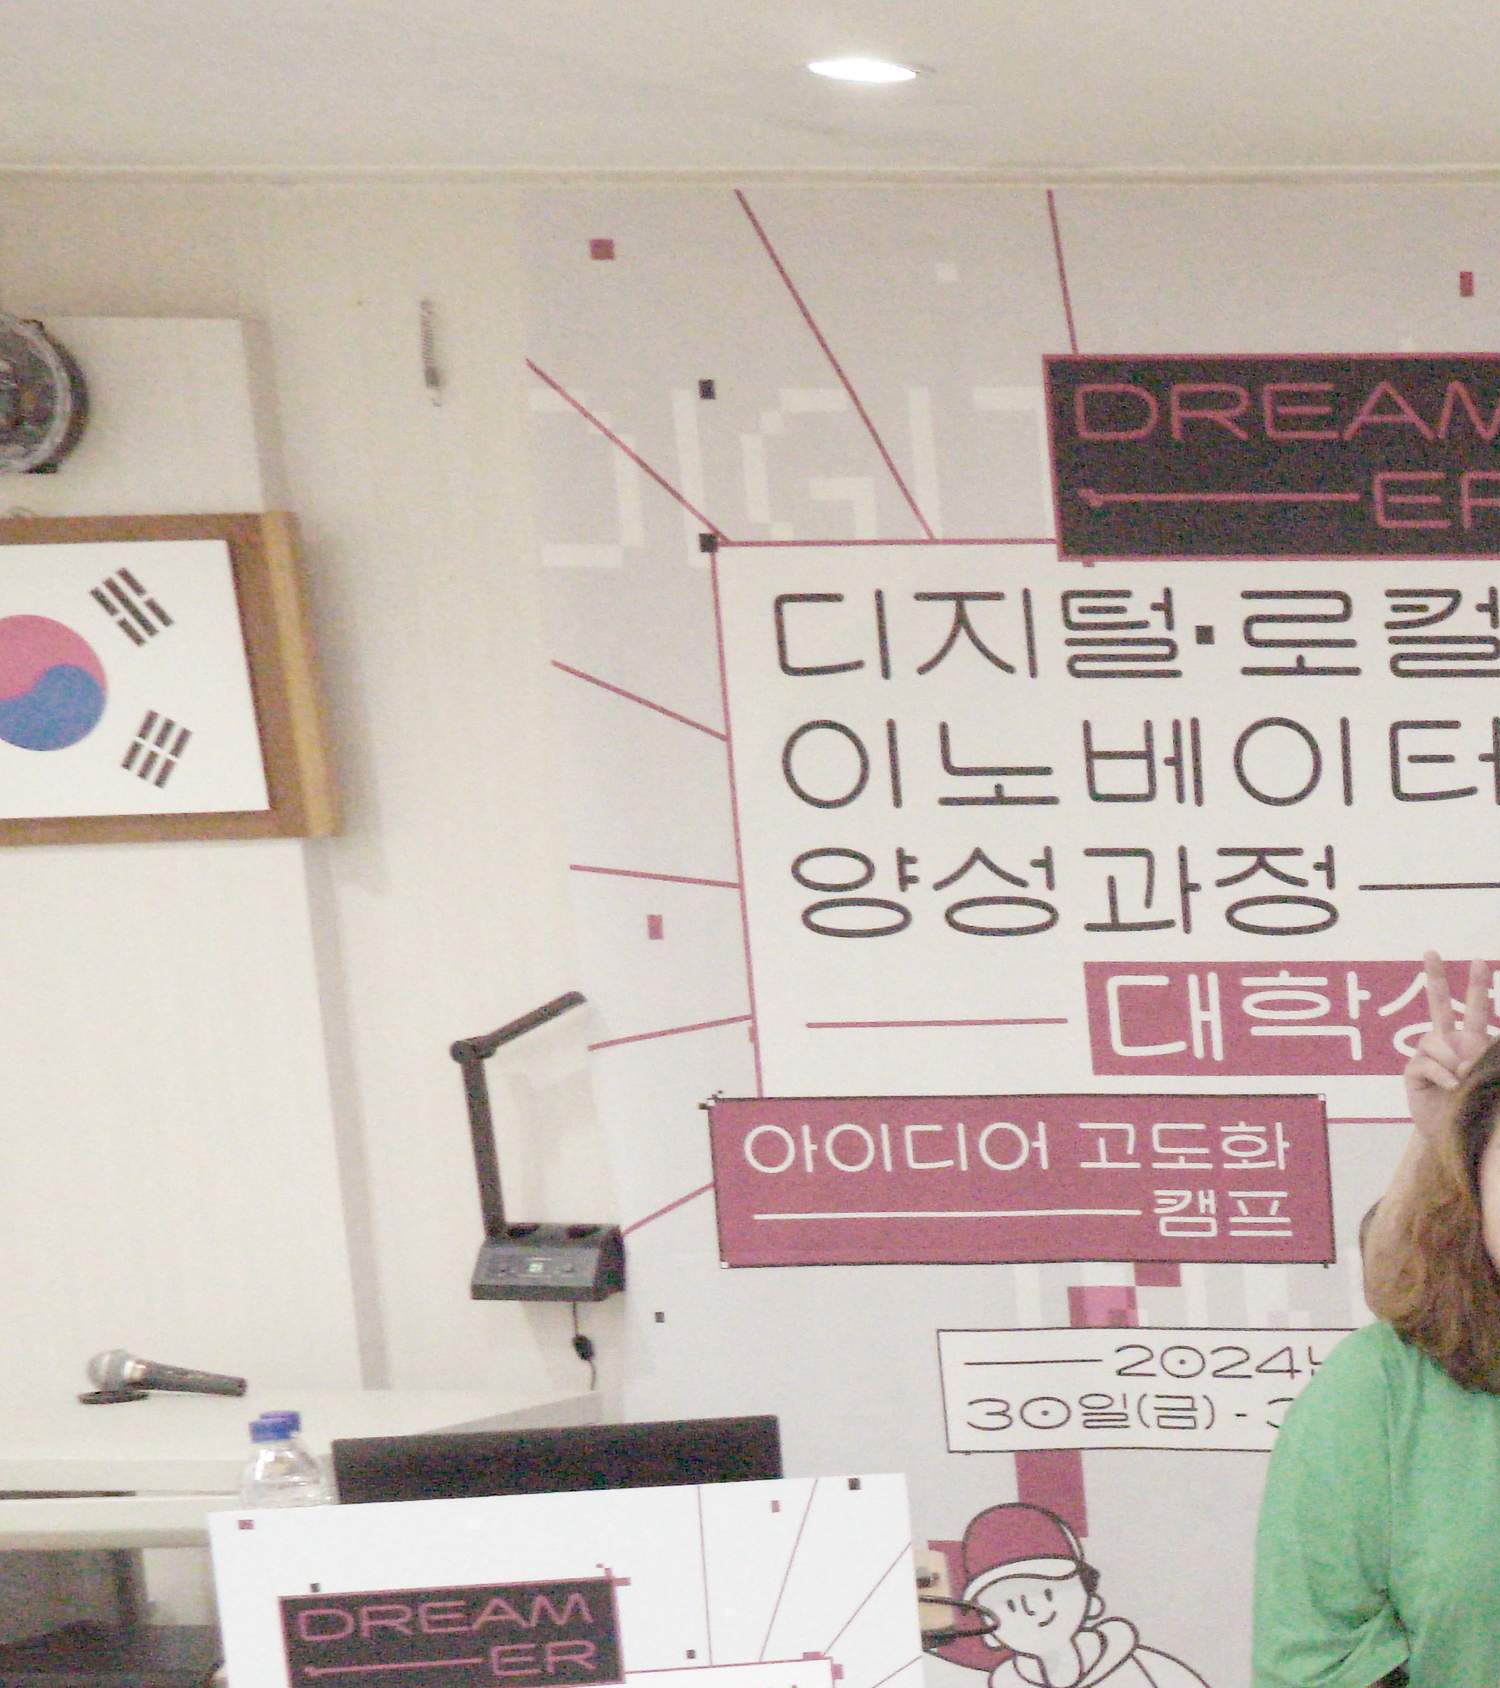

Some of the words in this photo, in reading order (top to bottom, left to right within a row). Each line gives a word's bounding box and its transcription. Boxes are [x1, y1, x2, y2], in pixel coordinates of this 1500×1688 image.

[790, 846, 1338, 938] 양성과정
[743, 1121, 1050, 1175] 아이디어
[1080, 1120, 1290, 1172] 고도화
[1153, 1189, 1294, 1238] 캠프
[967, 1391, 1215, 1431] 30일(금)
[296, 1593, 595, 1643] DREAM
[490, 1640, 596, 1679] ER
